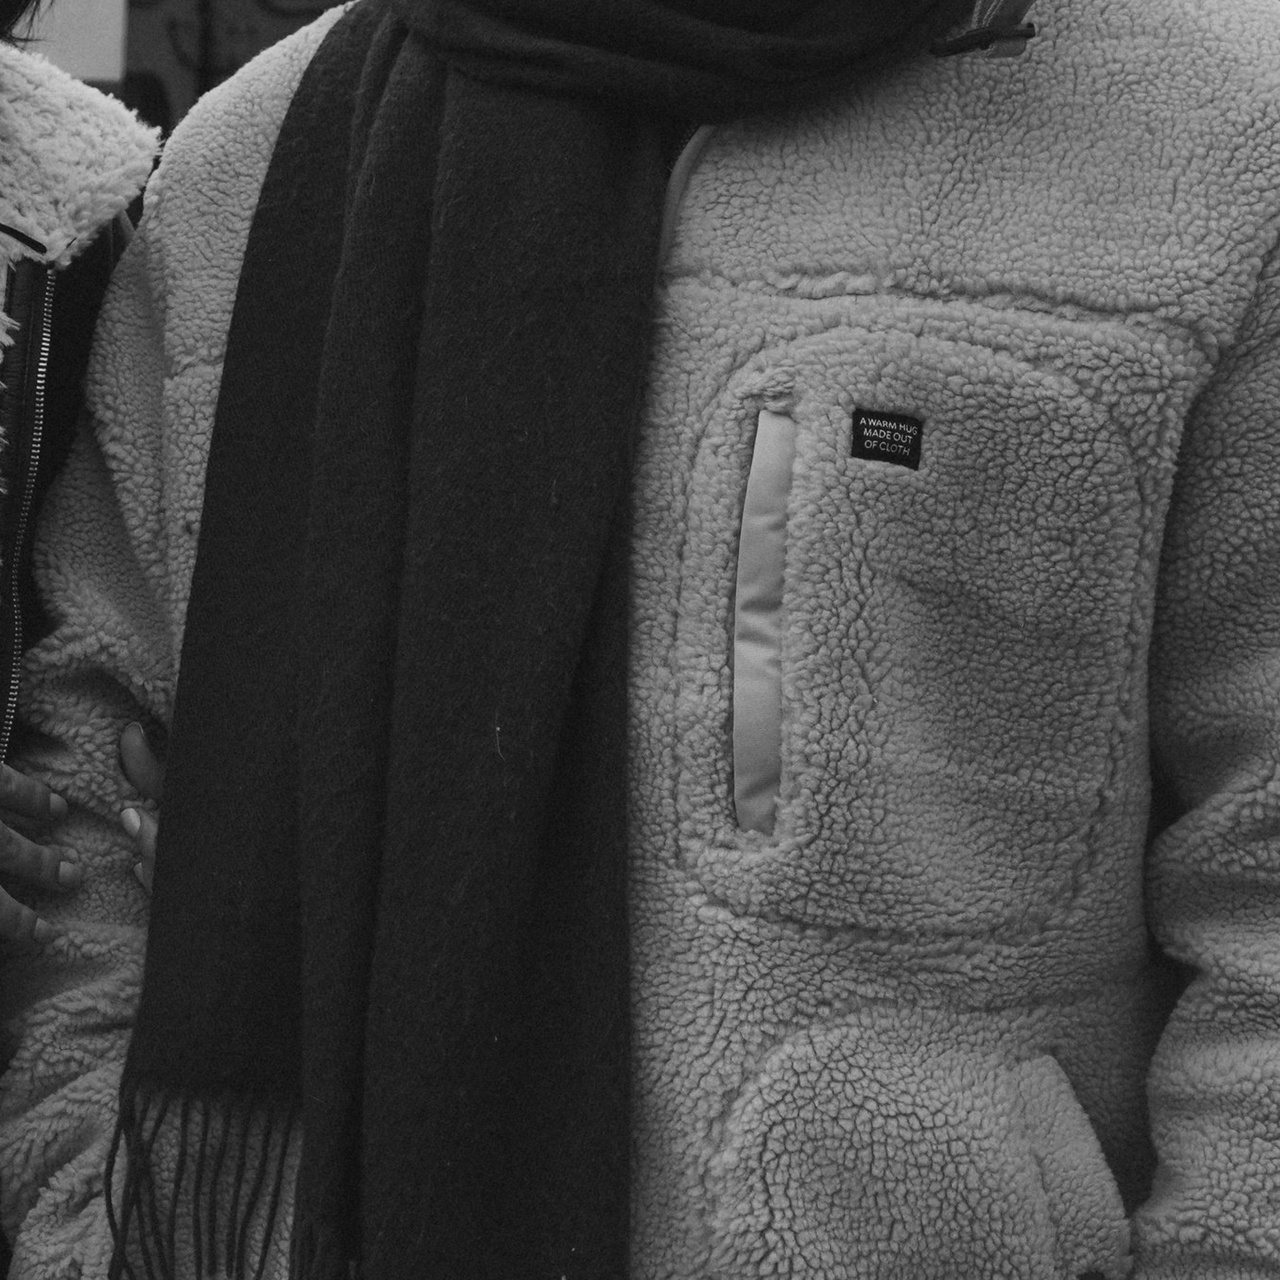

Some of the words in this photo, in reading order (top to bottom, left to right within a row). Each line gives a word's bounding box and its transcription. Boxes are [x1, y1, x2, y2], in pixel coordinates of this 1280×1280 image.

[860, 417, 867, 425] A
[867, 418, 897, 430] WARM
[899, 423, 918, 435] HUG
[863, 428, 891, 440] MADE
[893, 432, 913, 444] OUT
[864, 440, 878, 449] OF
[879, 441, 910, 456] CLOTH
